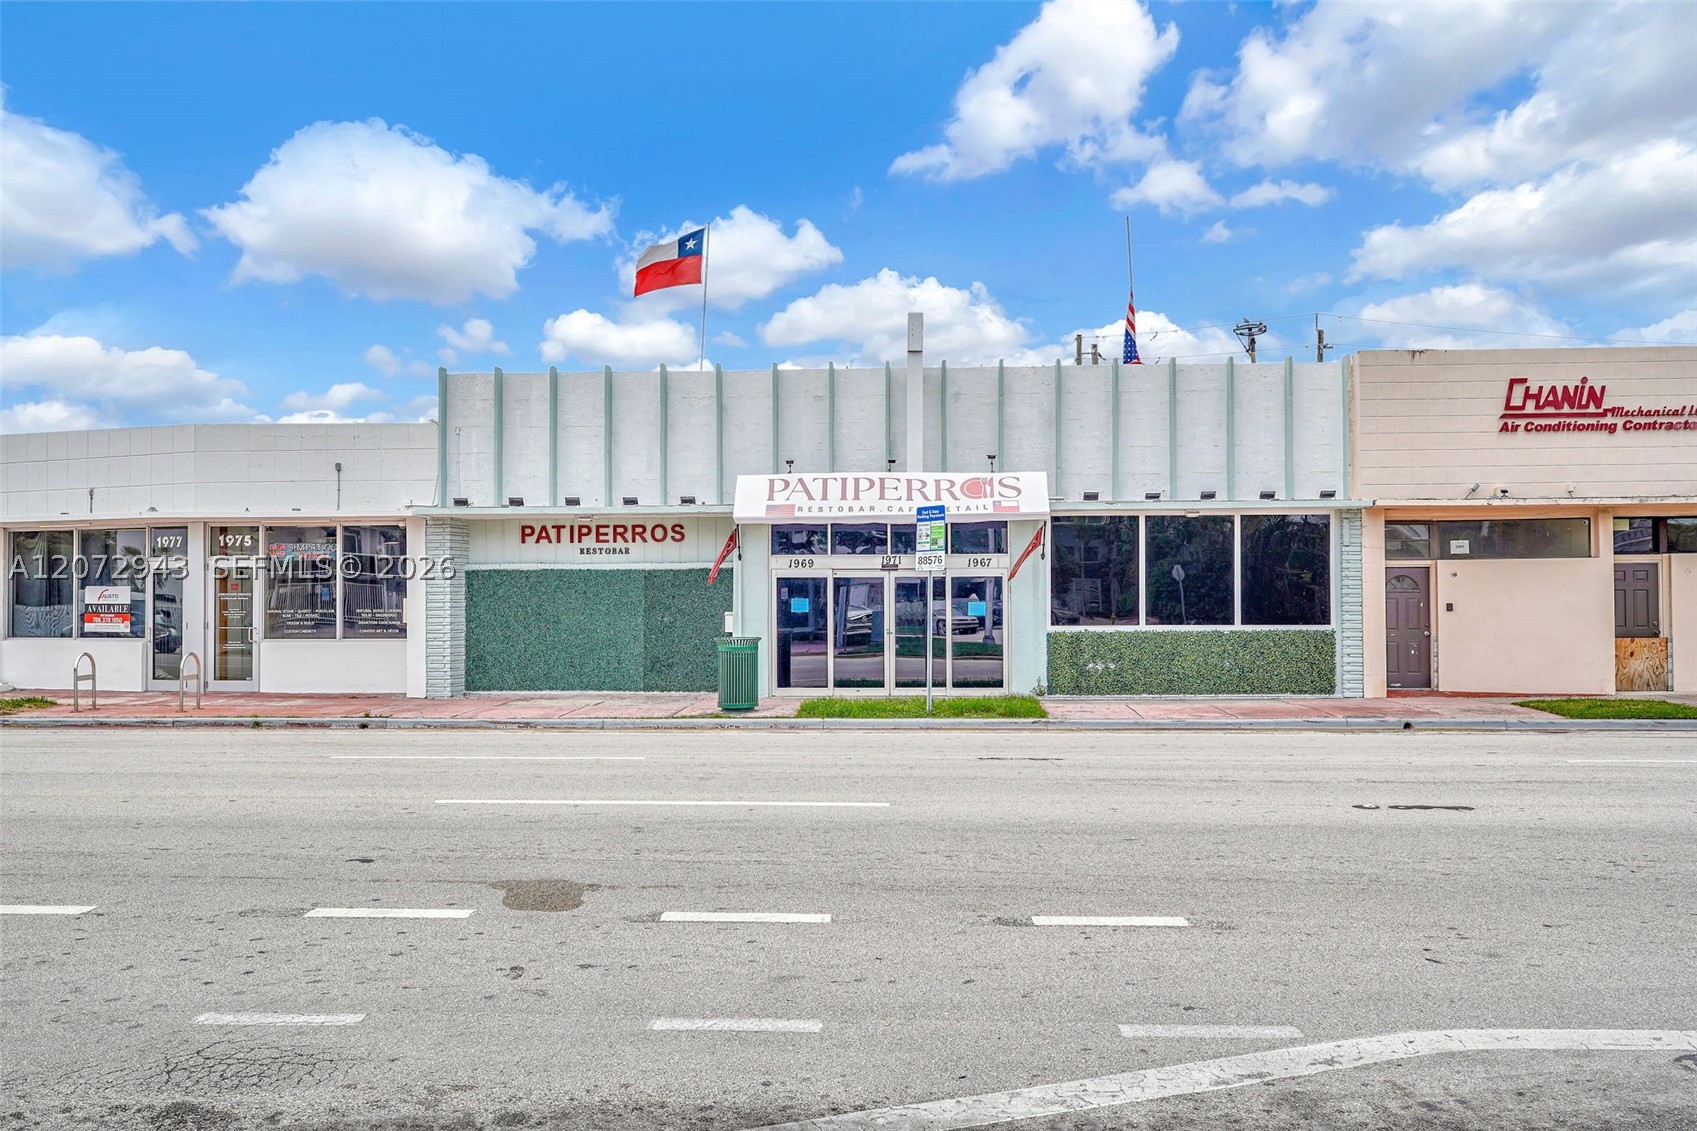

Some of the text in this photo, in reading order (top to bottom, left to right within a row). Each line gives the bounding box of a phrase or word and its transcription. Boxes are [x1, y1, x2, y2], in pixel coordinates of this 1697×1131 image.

[1611, 406, 1686, 418] Mechanical
[1500, 422, 1521, 433] Air
[1524, 419, 1617, 433] Conditioning
[766, 476, 1022, 501] PATIPERROS
[520, 524, 686, 543] PATIPERROS
[156, 536, 183, 548] 1977
[218, 534, 252, 547] 1975
[579, 547, 630, 555] RESTOBAR
[788, 559, 814, 568] 1969
[881, 555, 901, 566] 1971
[917, 555, 943, 565] 88576
[968, 558, 992, 567] 1967
[87, 604, 129, 613] AVAILABLE
